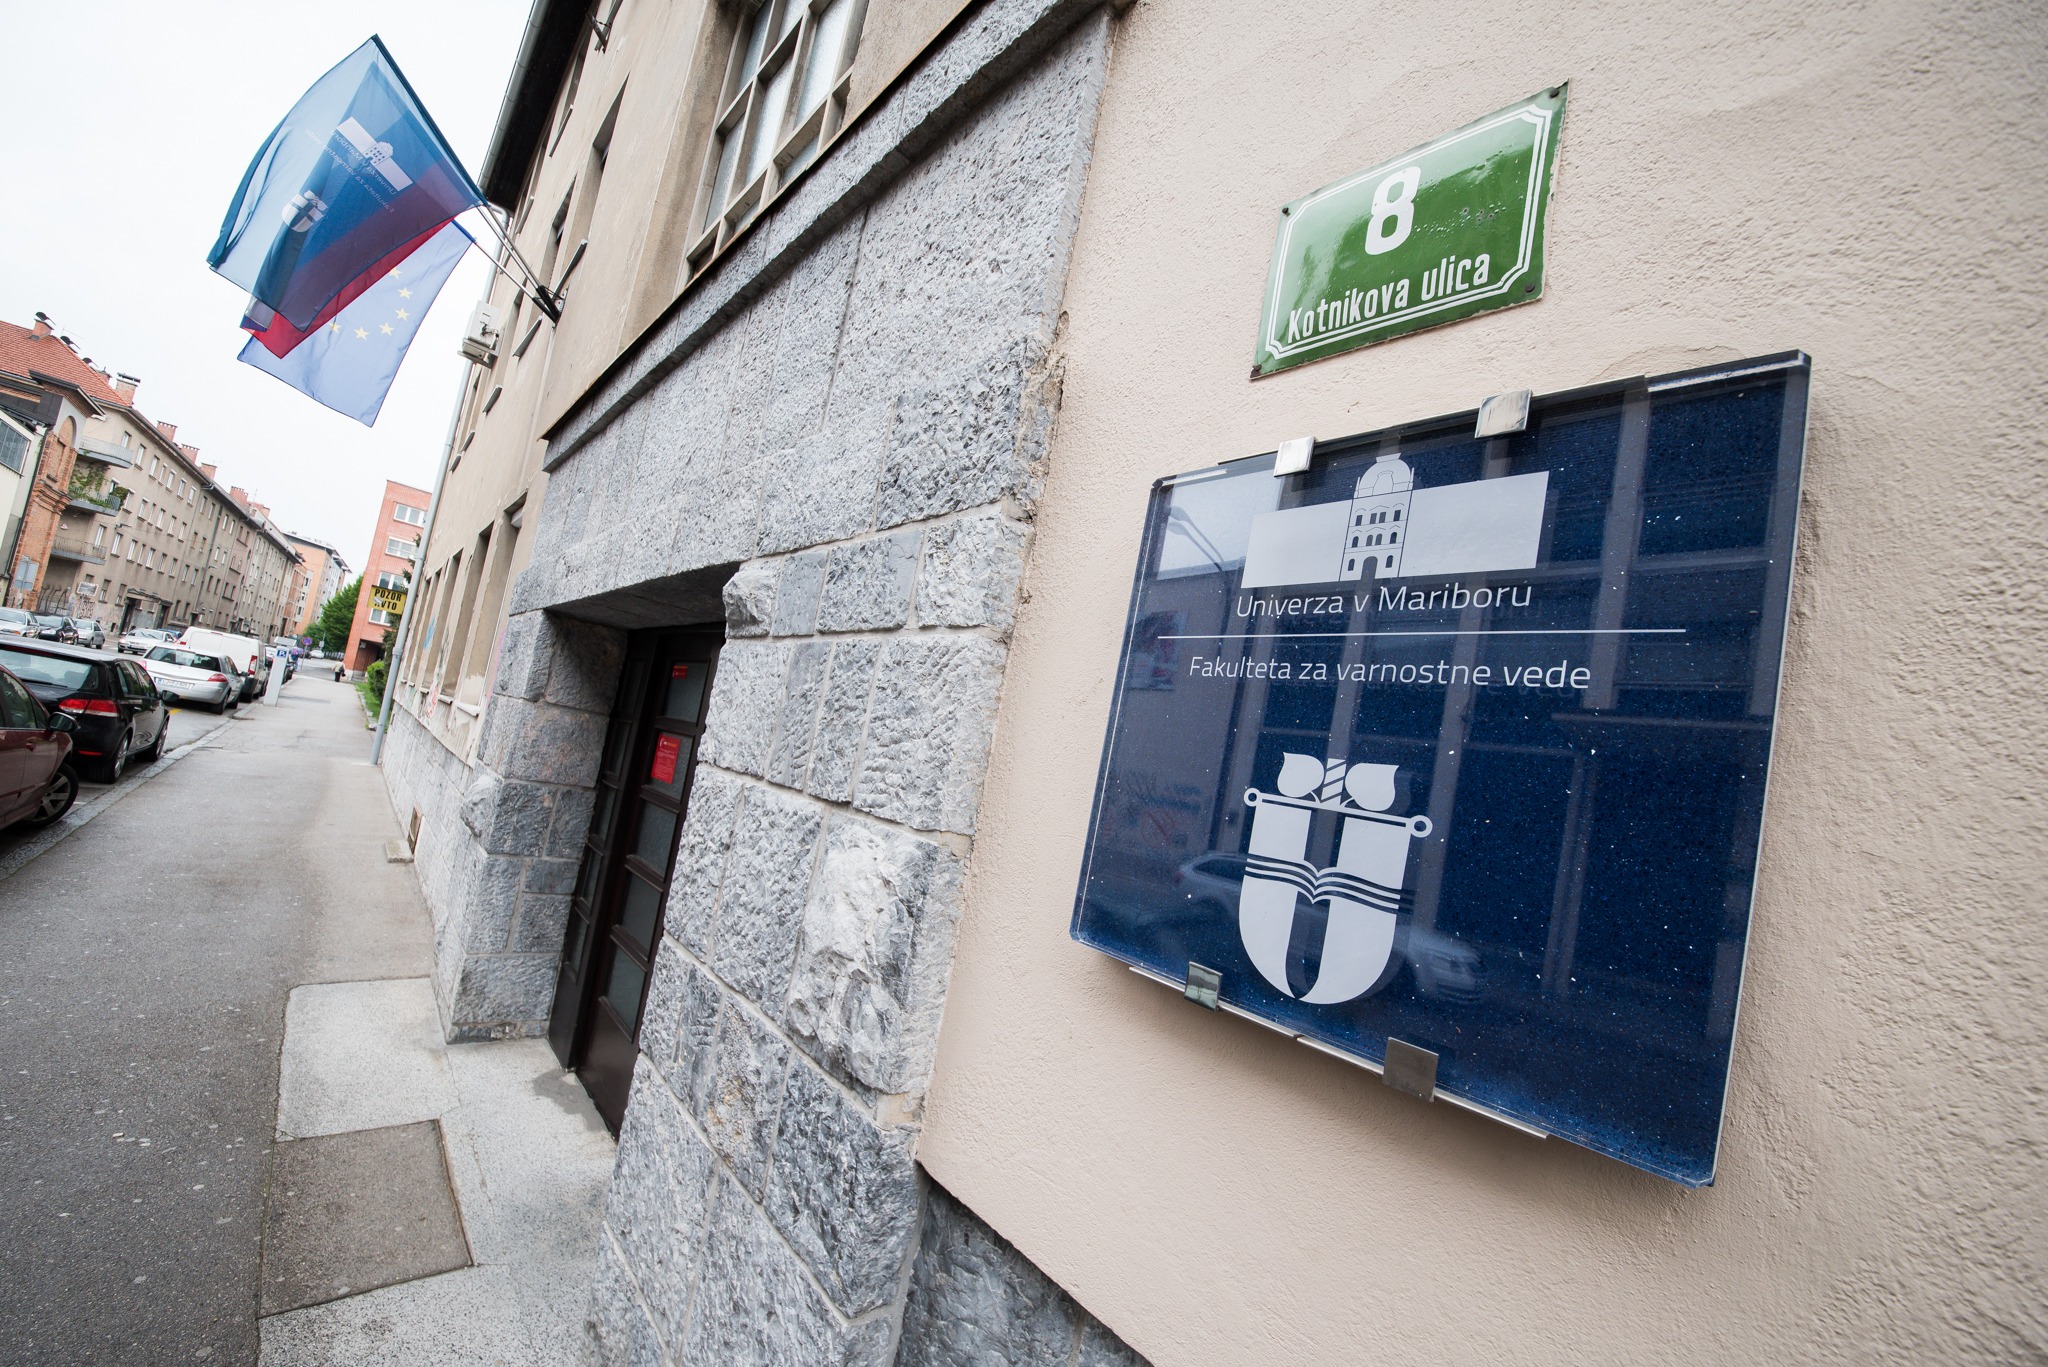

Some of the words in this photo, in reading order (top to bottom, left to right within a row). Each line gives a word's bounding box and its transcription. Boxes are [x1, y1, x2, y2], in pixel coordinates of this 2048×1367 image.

[1364, 166, 1422, 256] 8
[1287, 278, 1410, 344] Kotnikova
[1421, 253, 1490, 301] ulica
[374, 588, 402, 602] POZOR
[1236, 594, 1343, 617] Univerza
[1354, 594, 1370, 613] v
[1378, 582, 1532, 612] Mariboru
[1189, 656, 1291, 680] Fakulteta
[1298, 662, 1327, 681] za
[1337, 660, 1491, 686] varnostne
[1503, 660, 1591, 689] vede
